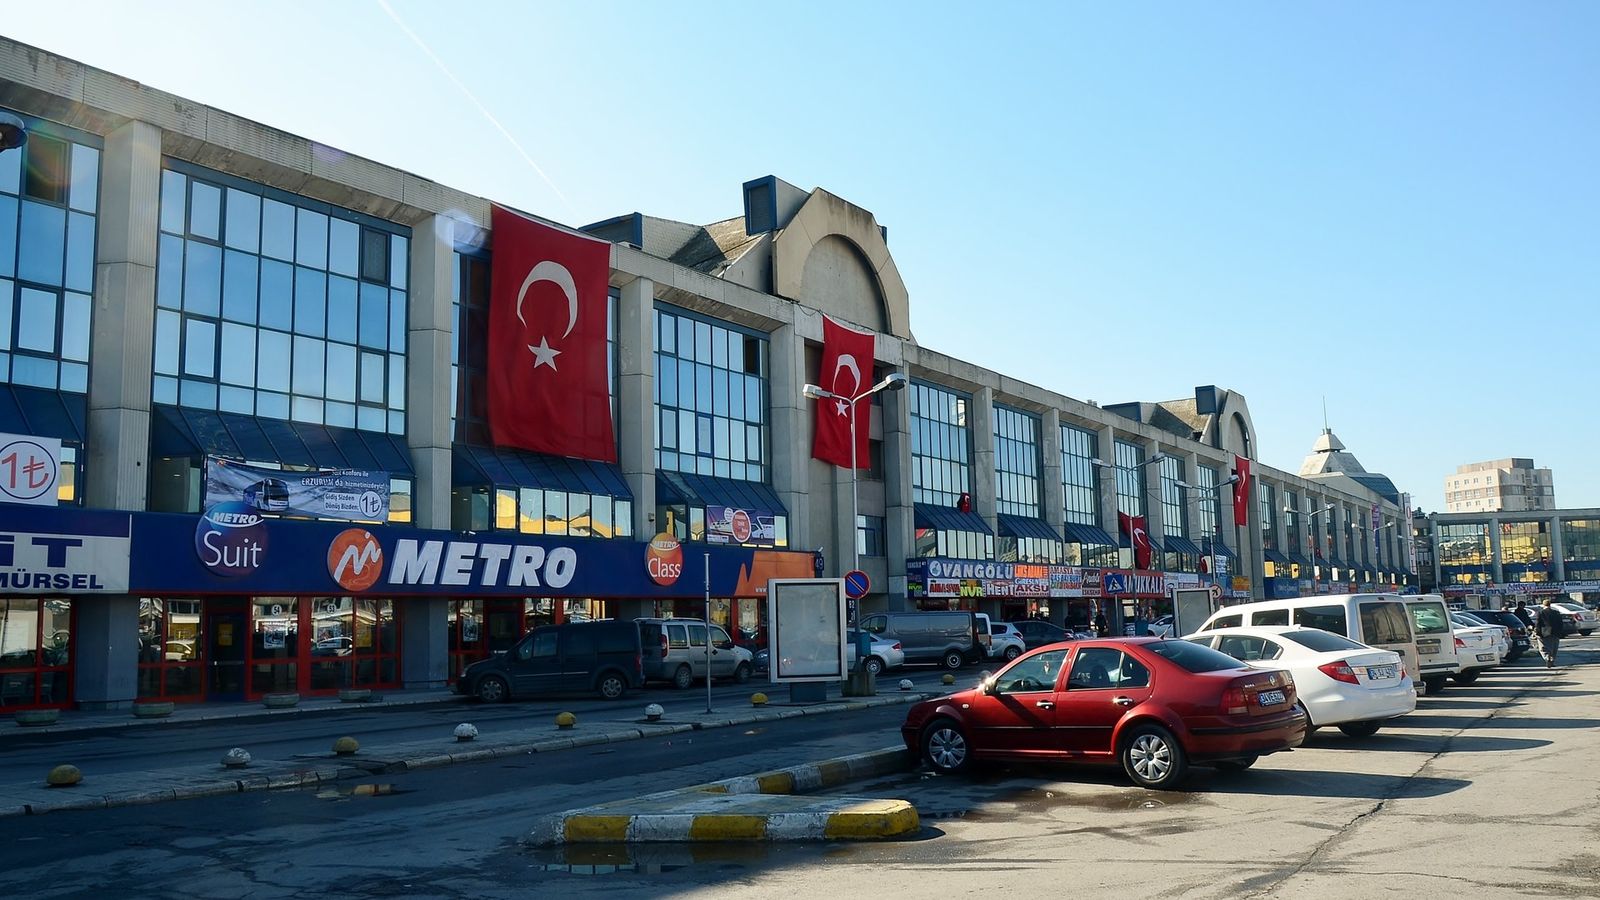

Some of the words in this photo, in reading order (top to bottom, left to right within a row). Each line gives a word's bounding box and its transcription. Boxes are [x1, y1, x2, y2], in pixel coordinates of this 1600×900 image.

[213, 512, 262, 525] METRO
[204, 530, 262, 568] Suit
[387, 538, 577, 589] METRO
[648, 557, 681, 578] Class
[943, 562, 1014, 580] VANGÖLÜ
